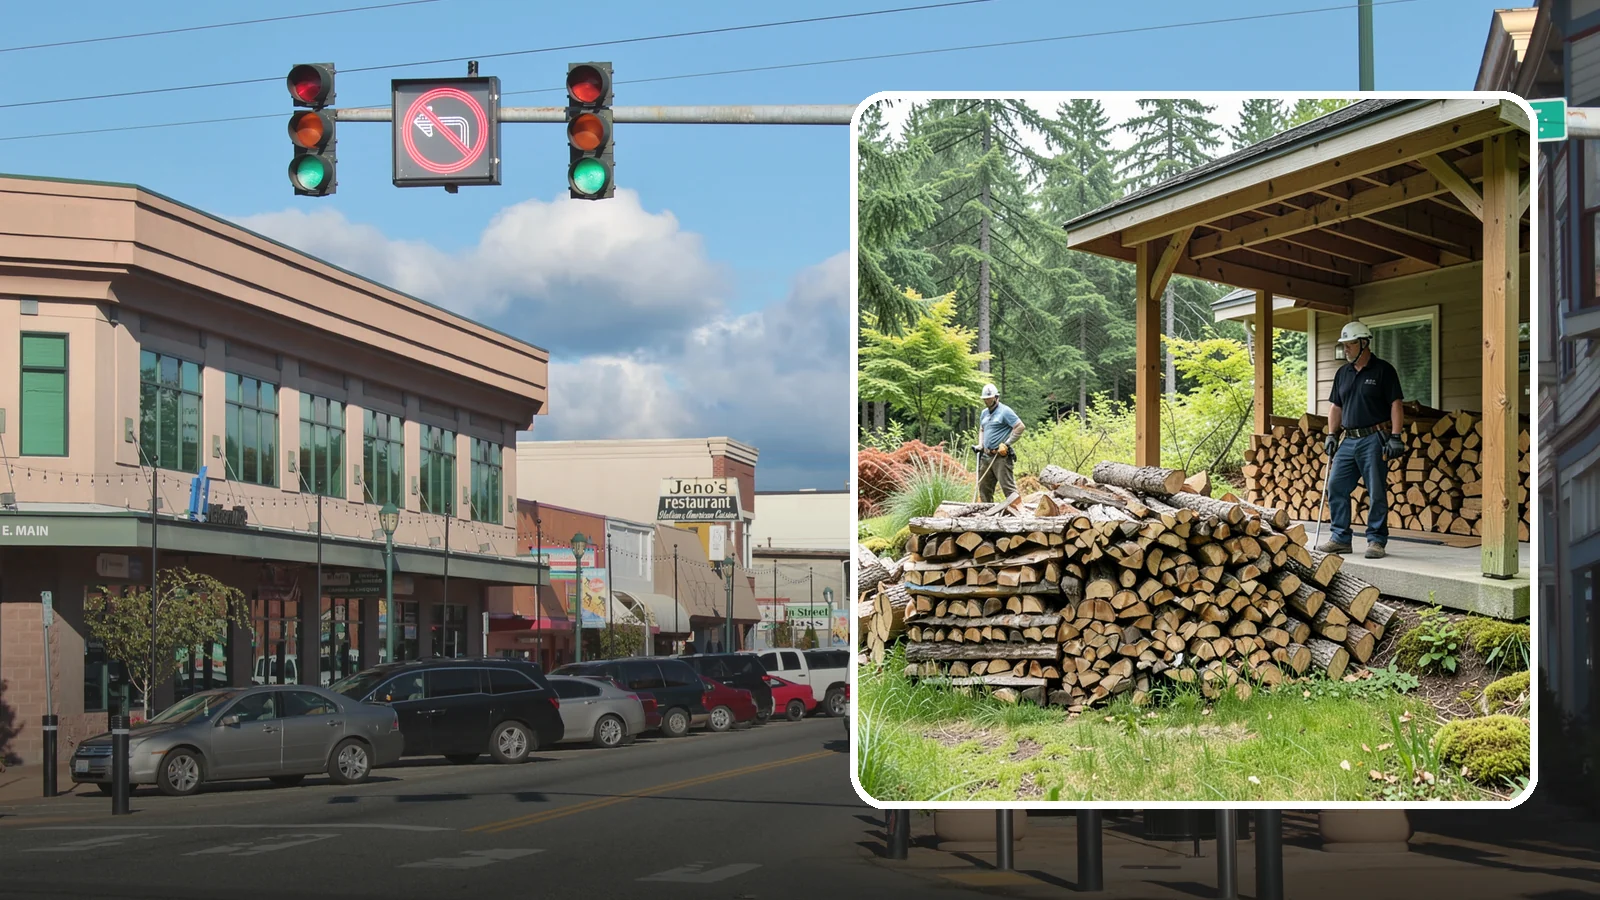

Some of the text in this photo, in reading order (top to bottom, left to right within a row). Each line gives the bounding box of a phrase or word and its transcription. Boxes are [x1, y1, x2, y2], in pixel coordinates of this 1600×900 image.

[669, 480, 728, 494] Jeno's
[665, 496, 731, 509] restaurant
[659, 510, 681, 519] Italian
[686, 510, 714, 519] American
[715, 510, 738, 519] Cuisine
[2, 525, 49, 536] E. MAIN
[797, 607, 828, 617] Street
